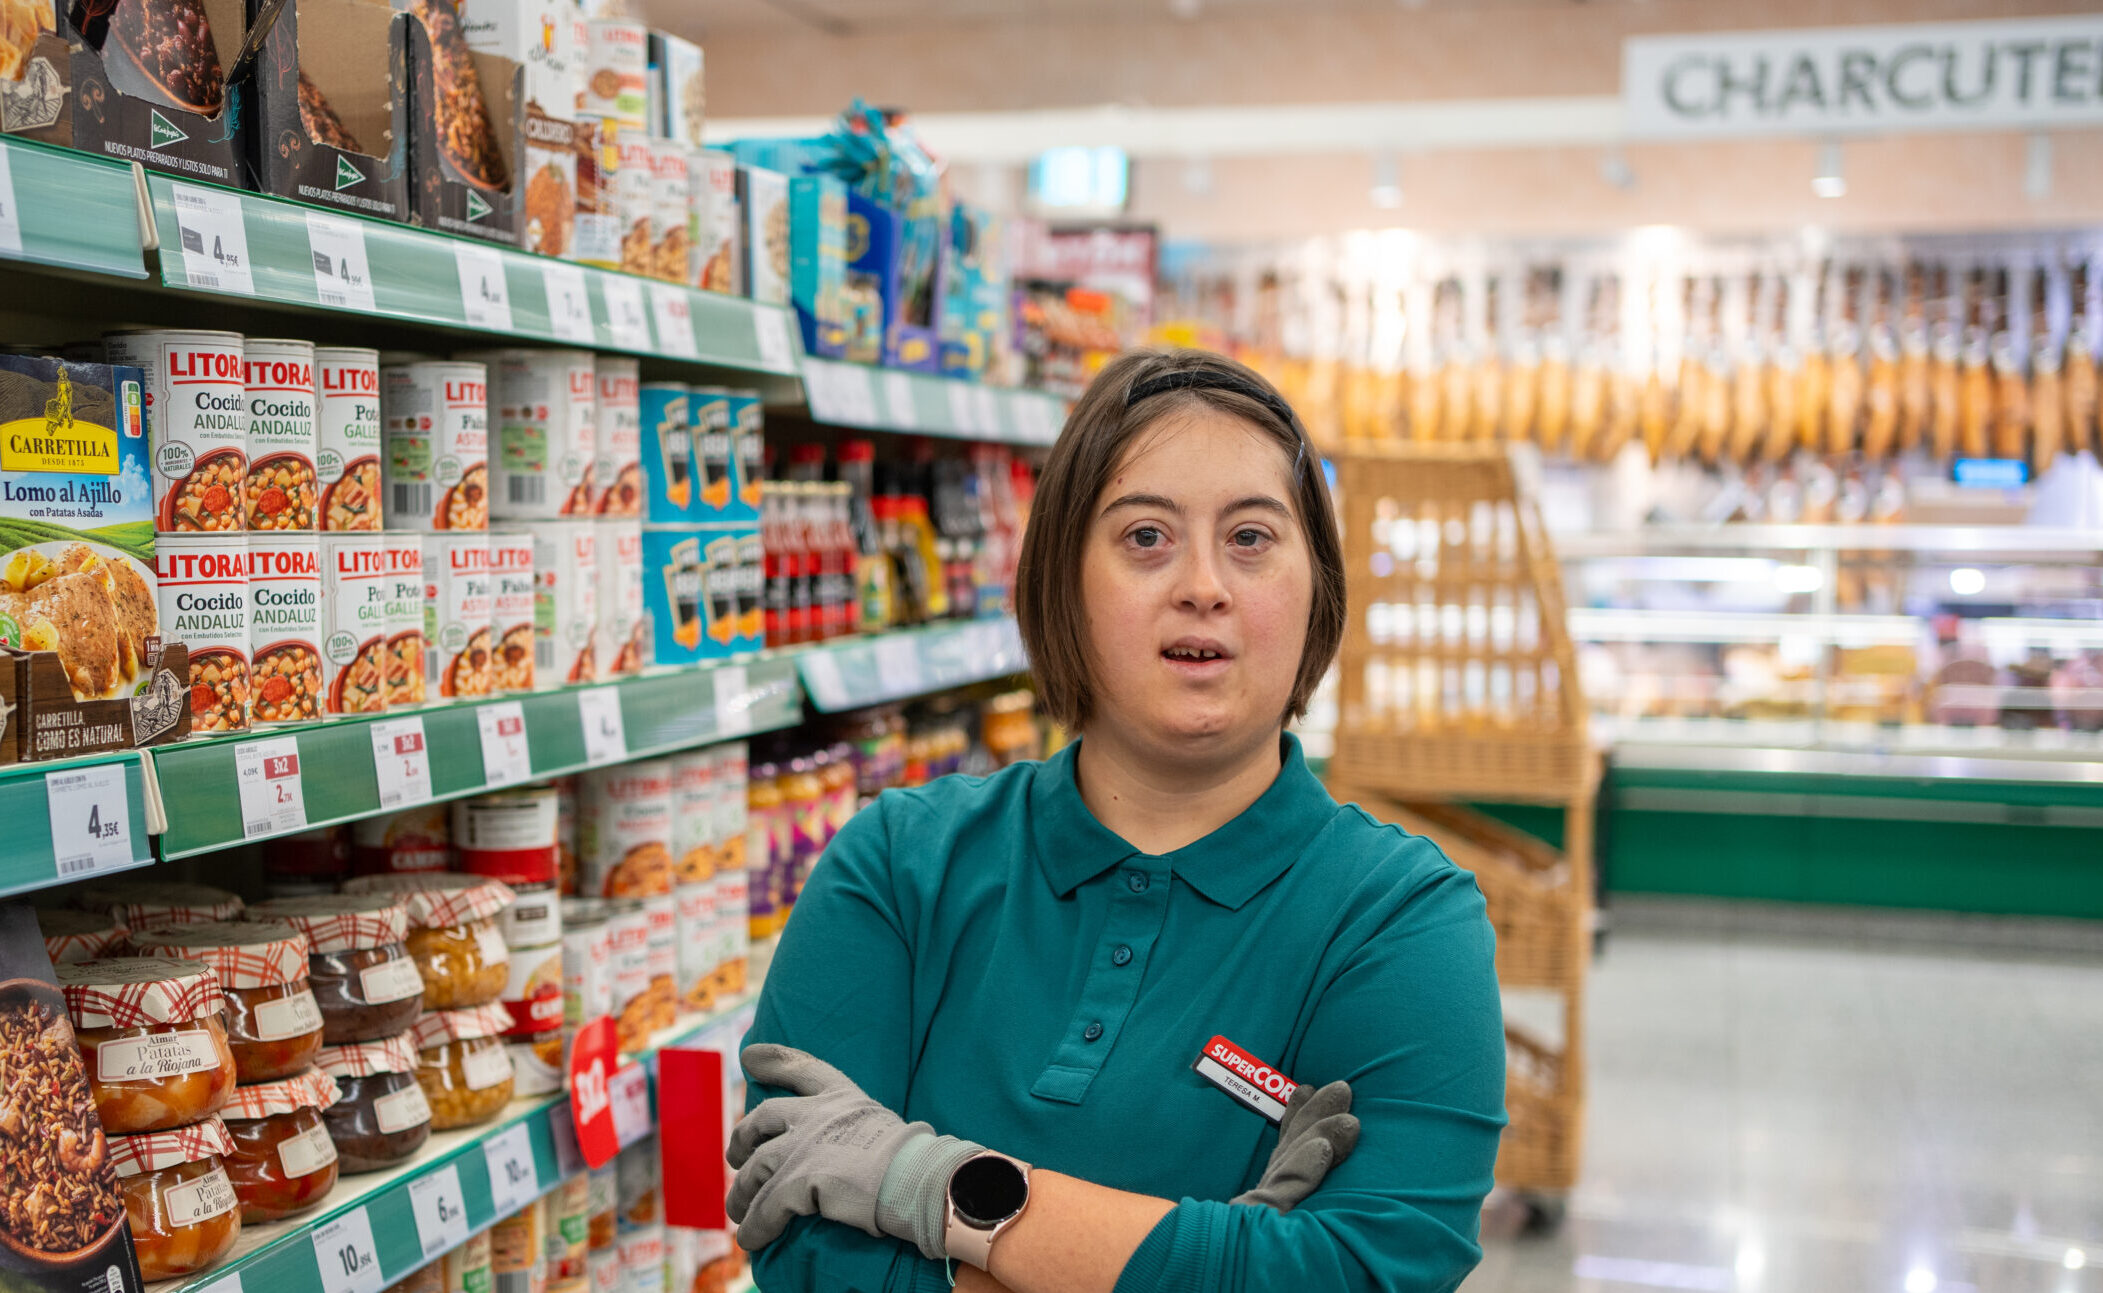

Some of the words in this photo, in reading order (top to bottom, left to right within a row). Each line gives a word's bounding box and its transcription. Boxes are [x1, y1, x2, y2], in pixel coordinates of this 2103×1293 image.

[1660, 38, 2103, 118] CHARCUTE
[105, 141, 126, 156] NUEVOS
[127, 145, 146, 160] PLATOS
[147, 150, 178, 168] PREPARADOS
[182, 159, 198, 172] LISTOS
[199, 163, 210, 175] SOLO
[251, 399, 311, 418] Cocido
[249, 420, 312, 436] ANDALUZ
[344, 424, 379, 439] GALLE
[10, 435, 110, 457] CARRETILLA
[163, 447, 189, 460] 100%
[42, 458, 64, 466] DESDE
[163, 463, 191, 472] NATURALES
[4, 481, 56, 502] Lomo
[60, 480, 75, 502] al
[79, 481, 121, 509] Ajillo
[30, 508, 44, 517] con
[46, 507, 75, 517] Patatas
[77, 508, 103, 518] Asadas
[249, 552, 320, 574] ITORAL
[177, 593, 243, 611] Cocido
[255, 589, 315, 606] Cocido
[175, 614, 244, 630] ANDALUZ
[253, 608, 316, 624] ANDALUZ
[194, 632, 223, 640] Embutidos
[36, 711, 86, 728] CARRETILLA,
[36, 730, 65, 752] COMO
[68, 730, 80, 748] ES
[82, 724, 124, 747] NATURAL
[273, 757, 289, 775] 3x2
[88, 804, 119, 839] 4,35€
[149, 1036, 177, 1045] Aimar
[137, 1046, 192, 1061] Patatas
[126, 1066, 137, 1075] a
[140, 1062, 154, 1074] la
[157, 1058, 201, 1074] Riojana
[1224, 1076, 1251, 1097] TERESA
[1253, 1094, 1261, 1104] M.
[196, 1183, 228, 1202] Patatas
[193, 1207, 200, 1217] a
[203, 1200, 213, 1214] la
